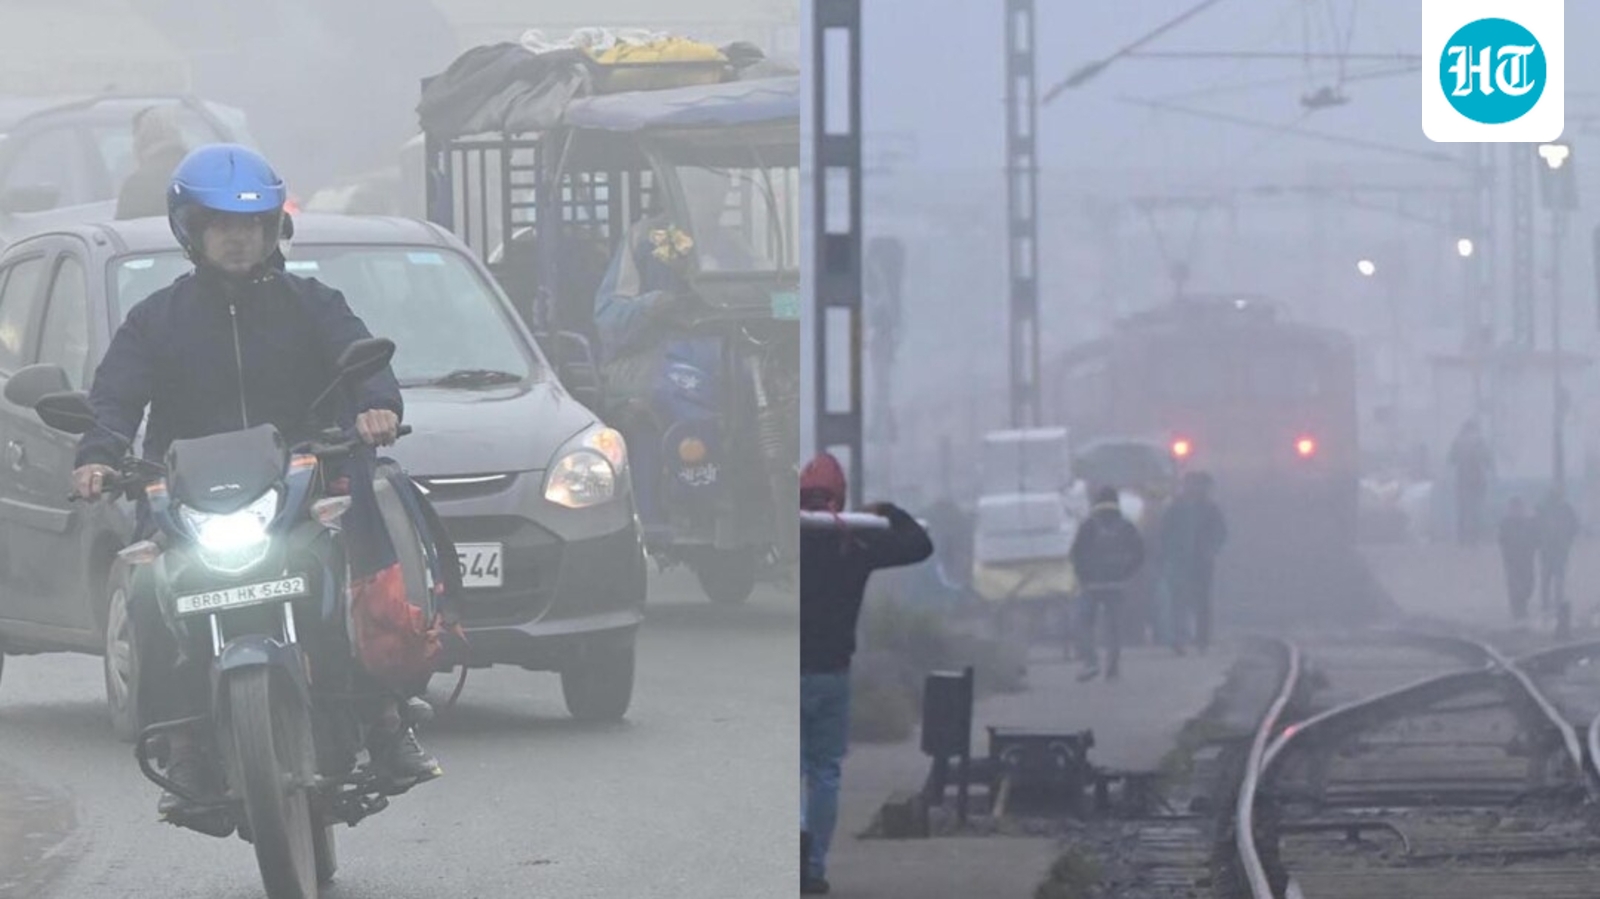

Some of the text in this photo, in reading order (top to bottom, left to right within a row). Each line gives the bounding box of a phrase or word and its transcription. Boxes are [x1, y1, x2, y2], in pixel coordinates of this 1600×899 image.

[191, 579, 301, 609] BR01 HK 5492
